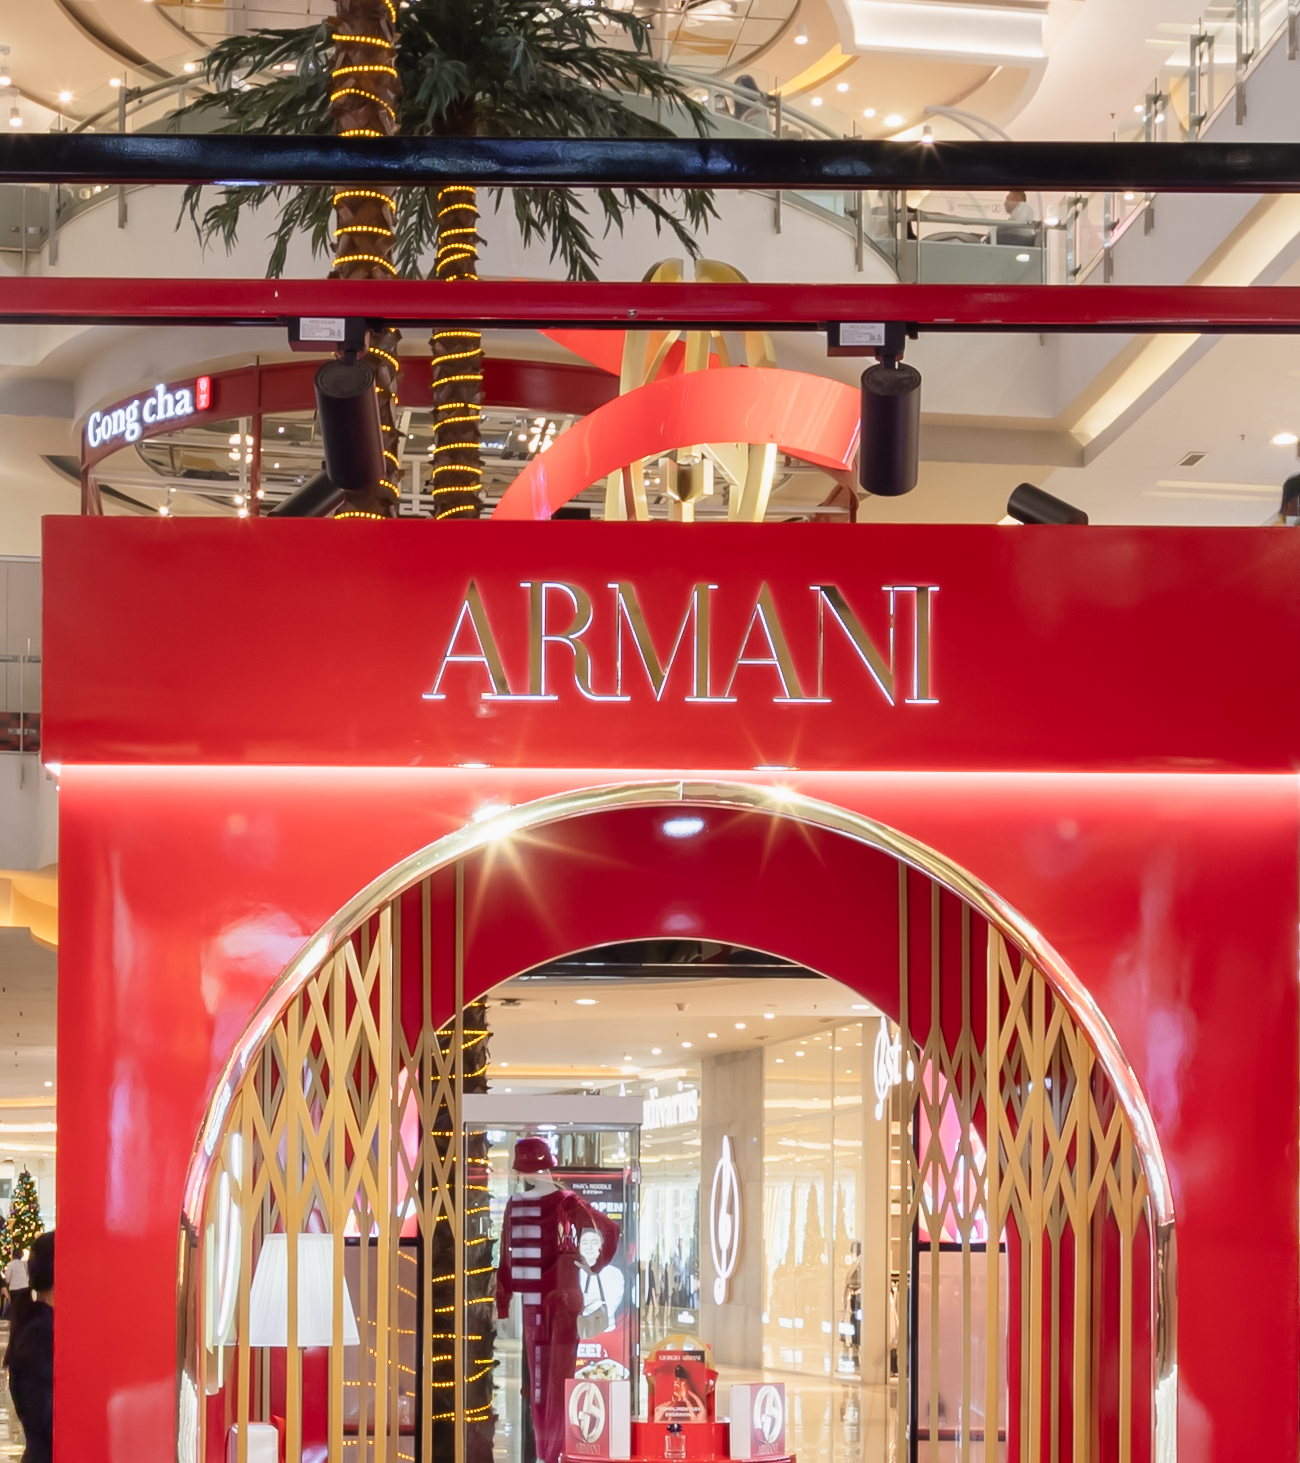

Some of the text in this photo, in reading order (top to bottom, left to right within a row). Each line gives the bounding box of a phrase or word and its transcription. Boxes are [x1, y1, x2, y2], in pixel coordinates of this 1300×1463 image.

[87, 383, 194, 448] Gong cha
[422, 578, 940, 707] ARMANI
